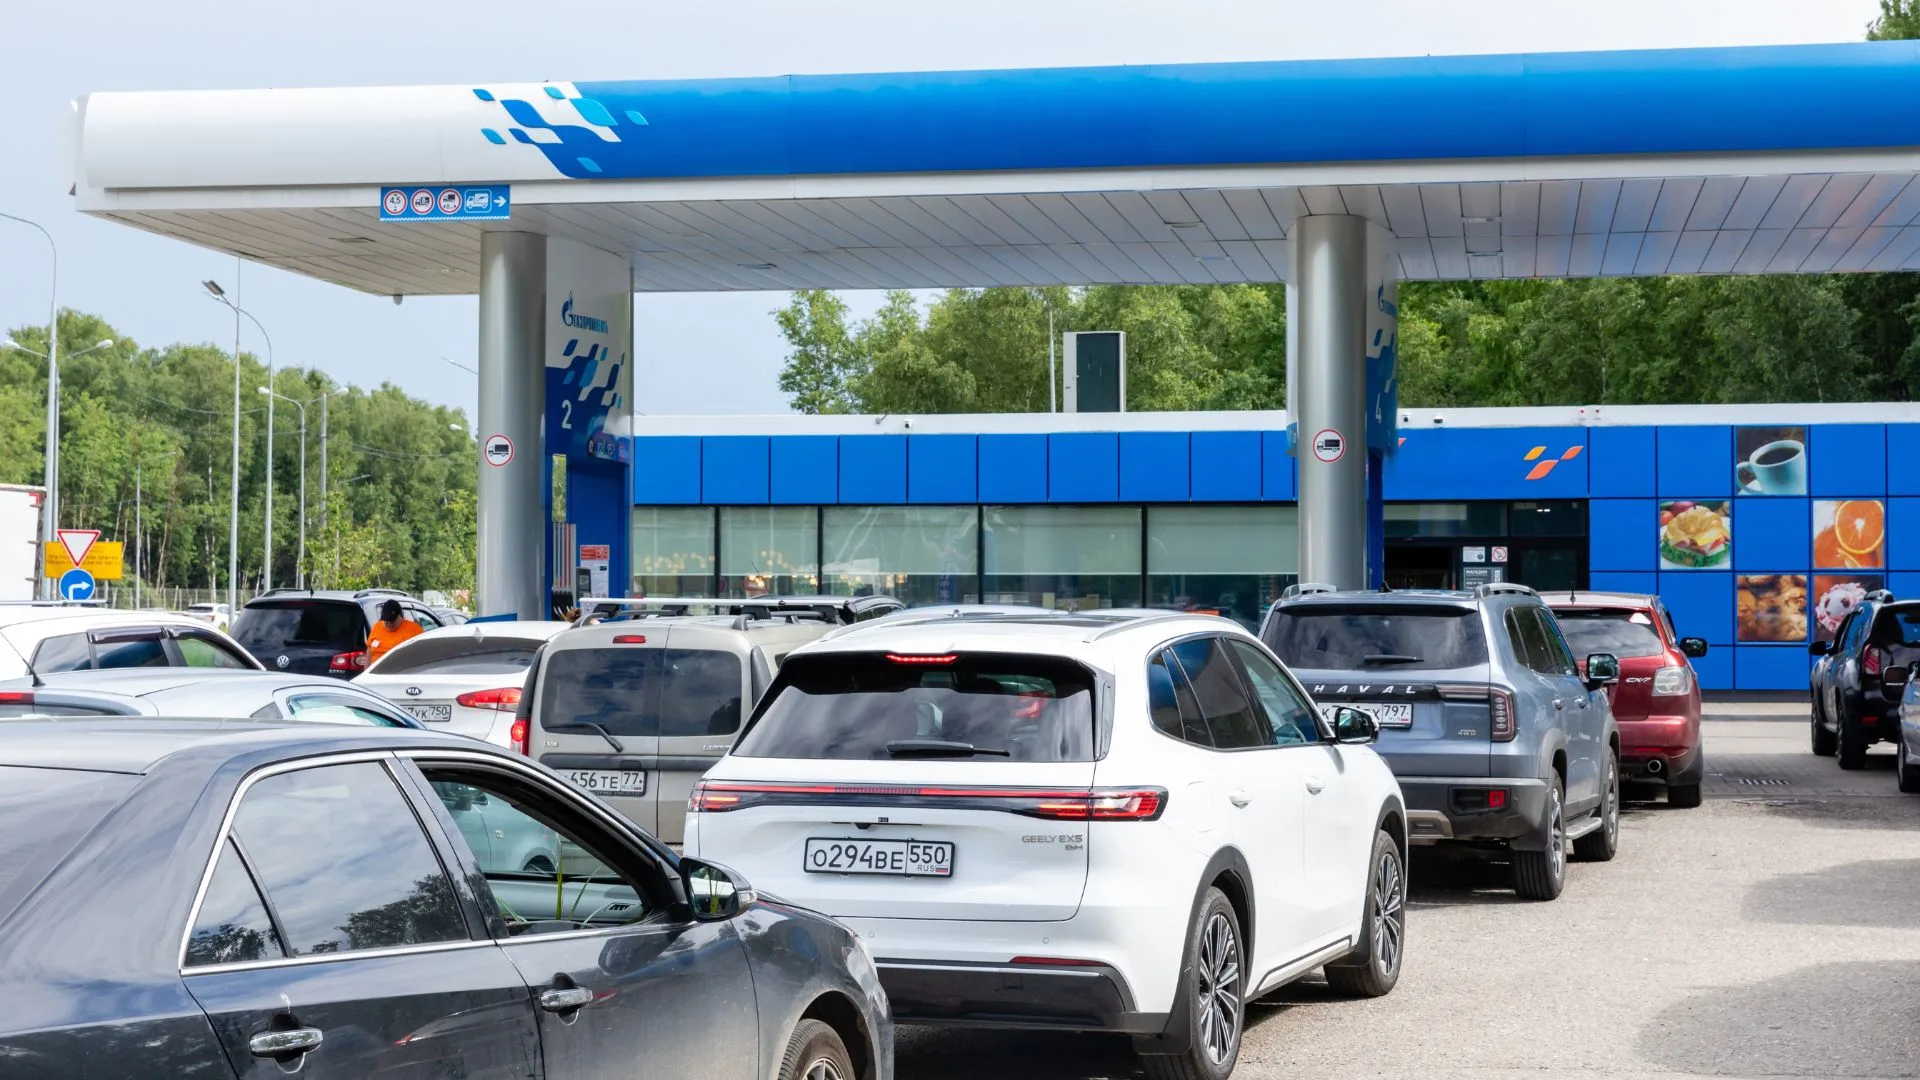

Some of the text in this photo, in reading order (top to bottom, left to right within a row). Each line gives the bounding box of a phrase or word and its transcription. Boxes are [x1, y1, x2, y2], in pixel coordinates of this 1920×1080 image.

[561, 399, 572, 430] 2
[1313, 684, 1417, 694] HAVAL
[430, 706, 448, 716] 750
[1383, 705, 1407, 717] 797
[623, 772, 640, 785] 77
[1022, 835, 1057, 843] GEELY
[909, 845, 946, 864] 550
[917, 864, 935, 872] RUS
